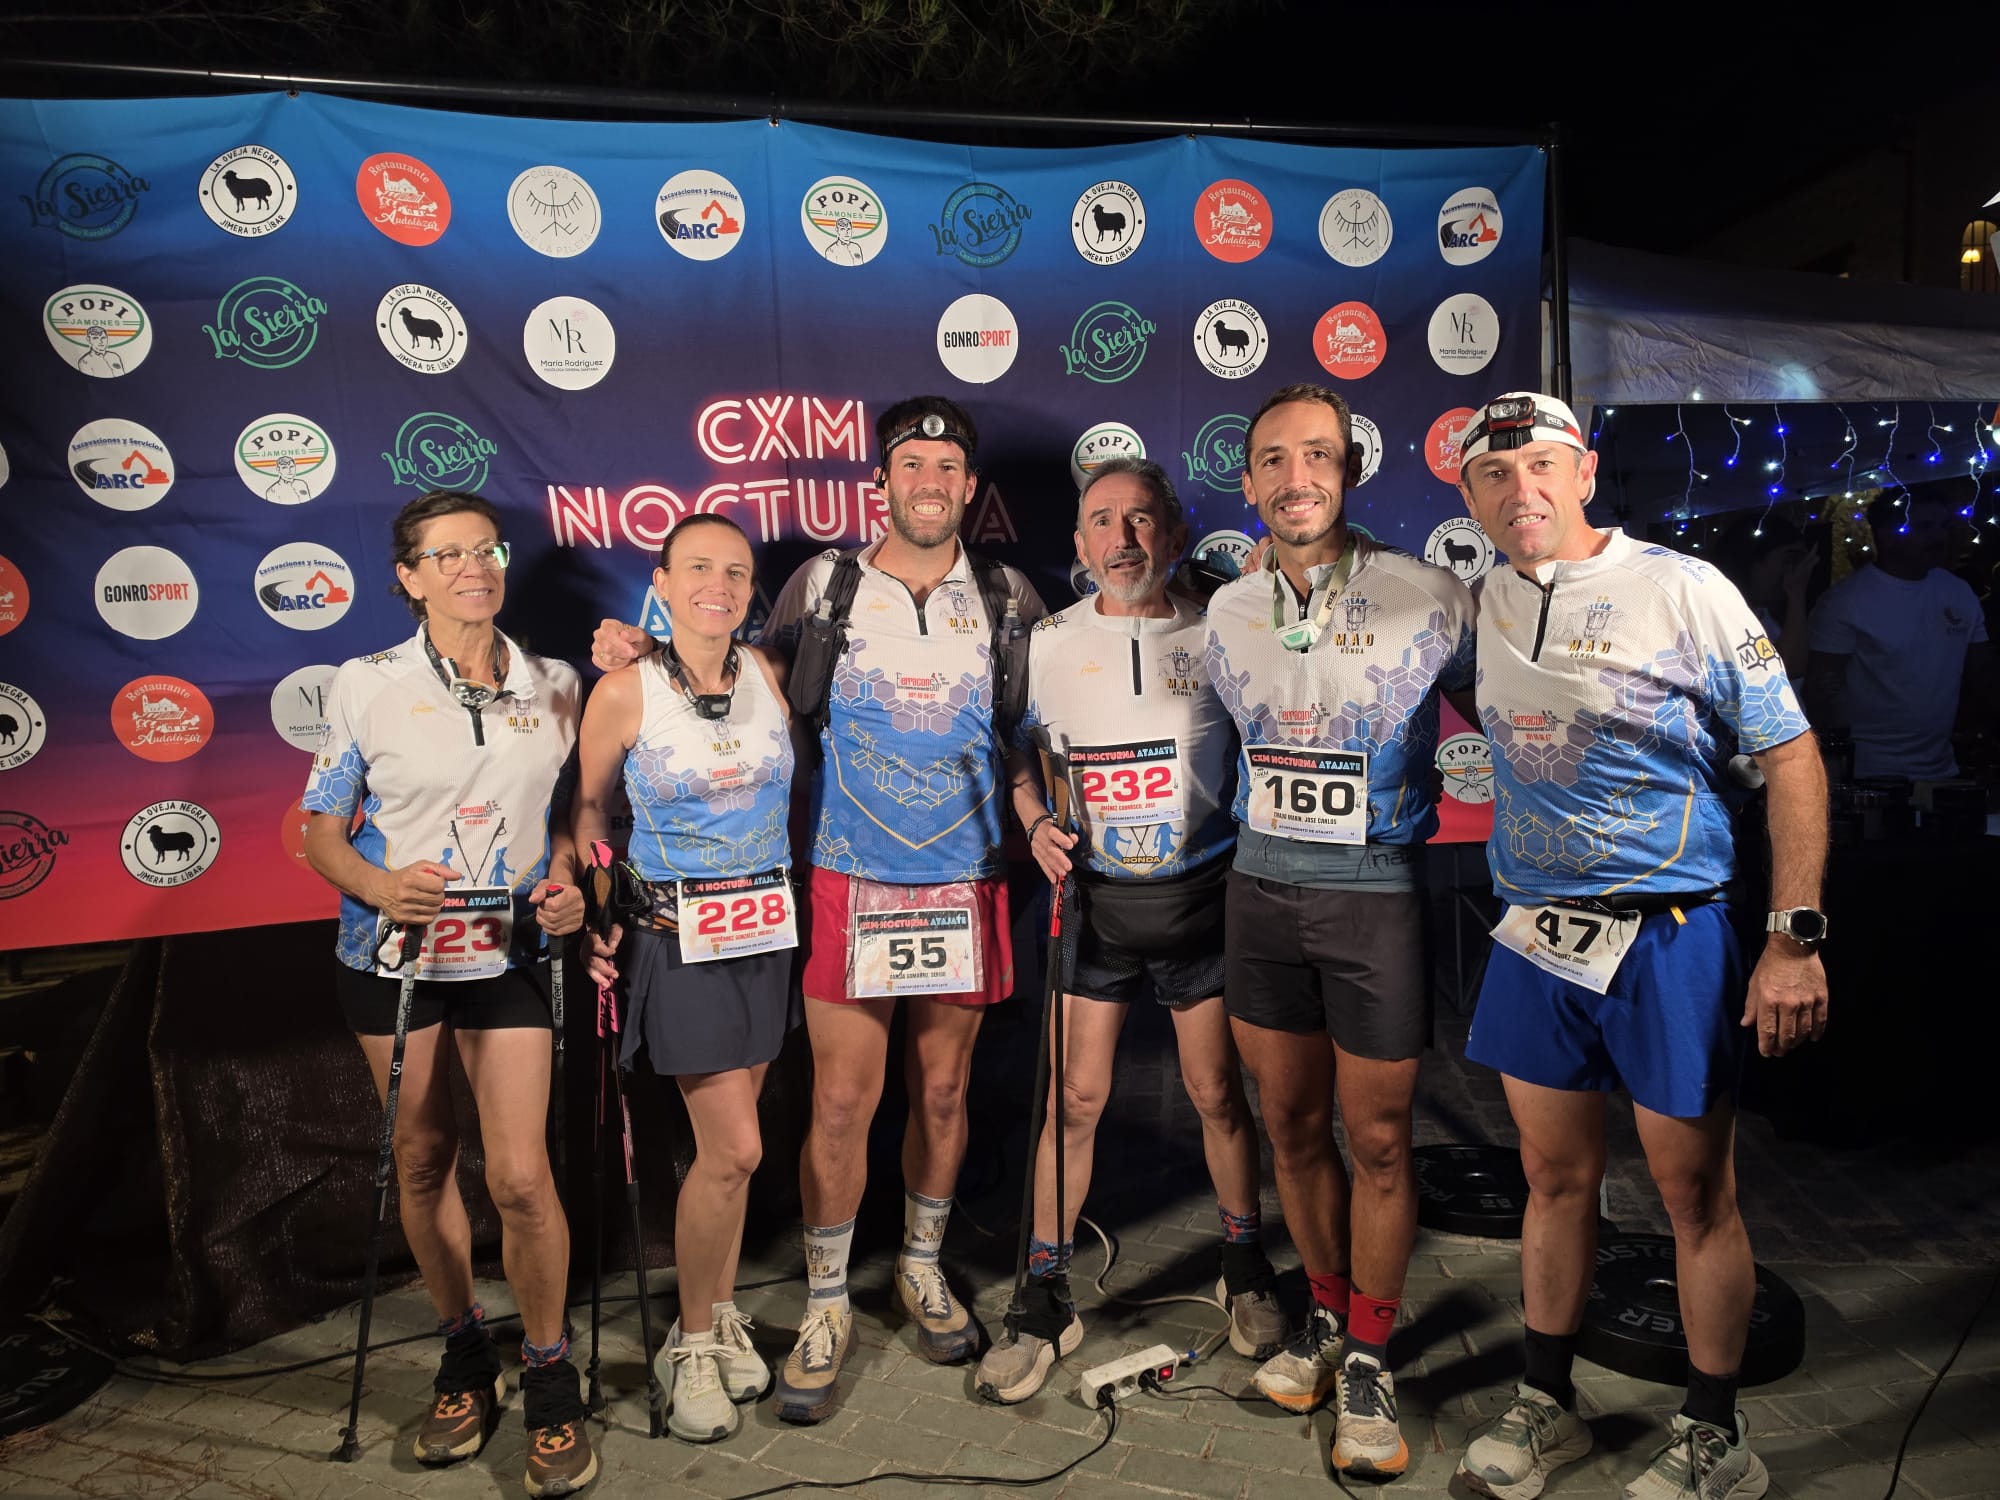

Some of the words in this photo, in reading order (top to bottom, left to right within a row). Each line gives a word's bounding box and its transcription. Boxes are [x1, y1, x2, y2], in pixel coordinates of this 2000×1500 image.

[210, 163, 221, 173] LA
[223, 147, 247, 162] OVEJA
[251, 147, 279, 166] NEGRA
[816, 191, 870, 212] POPI
[1081, 194, 1091, 205] LA
[1092, 182, 1114, 194] OVEJA
[1118, 184, 1137, 202] NEGRA
[220, 219, 248, 234] JIMERA
[252, 226, 262, 235] DE
[677, 223, 718, 239] ARC
[928, 224, 959, 256] La
[963, 204, 1032, 247] Sierra
[1448, 233, 1479, 248] ARC
[1082, 249, 1103, 262] JIMERA
[60, 298, 128, 319] POPI
[385, 295, 396, 305] LA
[396, 286, 422, 296] OVEJA
[426, 290, 453, 312] NEGRA
[1203, 309, 1213, 319] LA
[1214, 301, 1236, 310] OVEJA
[1239, 303, 1259, 322] NEGRA
[201, 324, 240, 359] La
[244, 297, 327, 347] Sierra
[944, 330, 1011, 348] GONROSPORT
[1059, 345, 1087, 375] La
[1092, 319, 1156, 364] Sierra
[396, 353, 423, 369] JIMERA
[1206, 361, 1226, 376] JIMERA
[697, 395, 867, 465] CXM
[1356, 416, 1376, 433] NEGRA
[251, 430, 314, 450] POPI
[1085, 436, 1132, 454] POPI
[261, 449, 307, 457] JAMONES
[381, 452, 417, 485] La
[420, 439, 497, 478] Sierra
[1091, 453, 1125, 461] JAMONES
[1182, 451, 1209, 481] La
[95, 473, 144, 489] ARC
[1433, 528, 1442, 539] LA
[1443, 518, 1464, 529] OVEJA
[104, 583, 189, 603] GONROSPORT
[279, 593, 326, 611] ARC
[1325, 589, 1337, 610] PETZL
[1334, 633, 1374, 646] MAD
[1568, 640, 1611, 654] MAD
[1087, 750, 1135, 762] NOCTURNA
[1137, 745, 1174, 758] ATAJATE
[1271, 755, 1317, 769] NOCTURNA
[1319, 761, 1360, 771] ATAJATE
[1446, 745, 1491, 761] POPI
[1082, 766, 1173, 803] 232
[1265, 775, 1355, 816] 160
[133, 815, 145, 826] LA
[147, 802, 175, 815] OVEJA
[180, 803, 207, 821] NEGRA
[1122, 856, 1161, 864] RONDA
[137, 871, 164, 884] JIMERA
[167, 876, 178, 884] DE
[697, 894, 786, 935] 228
[930, 915, 967, 925] ATAJATE
[1535, 909, 1601, 954] 47
[889, 937, 947, 971] 55
